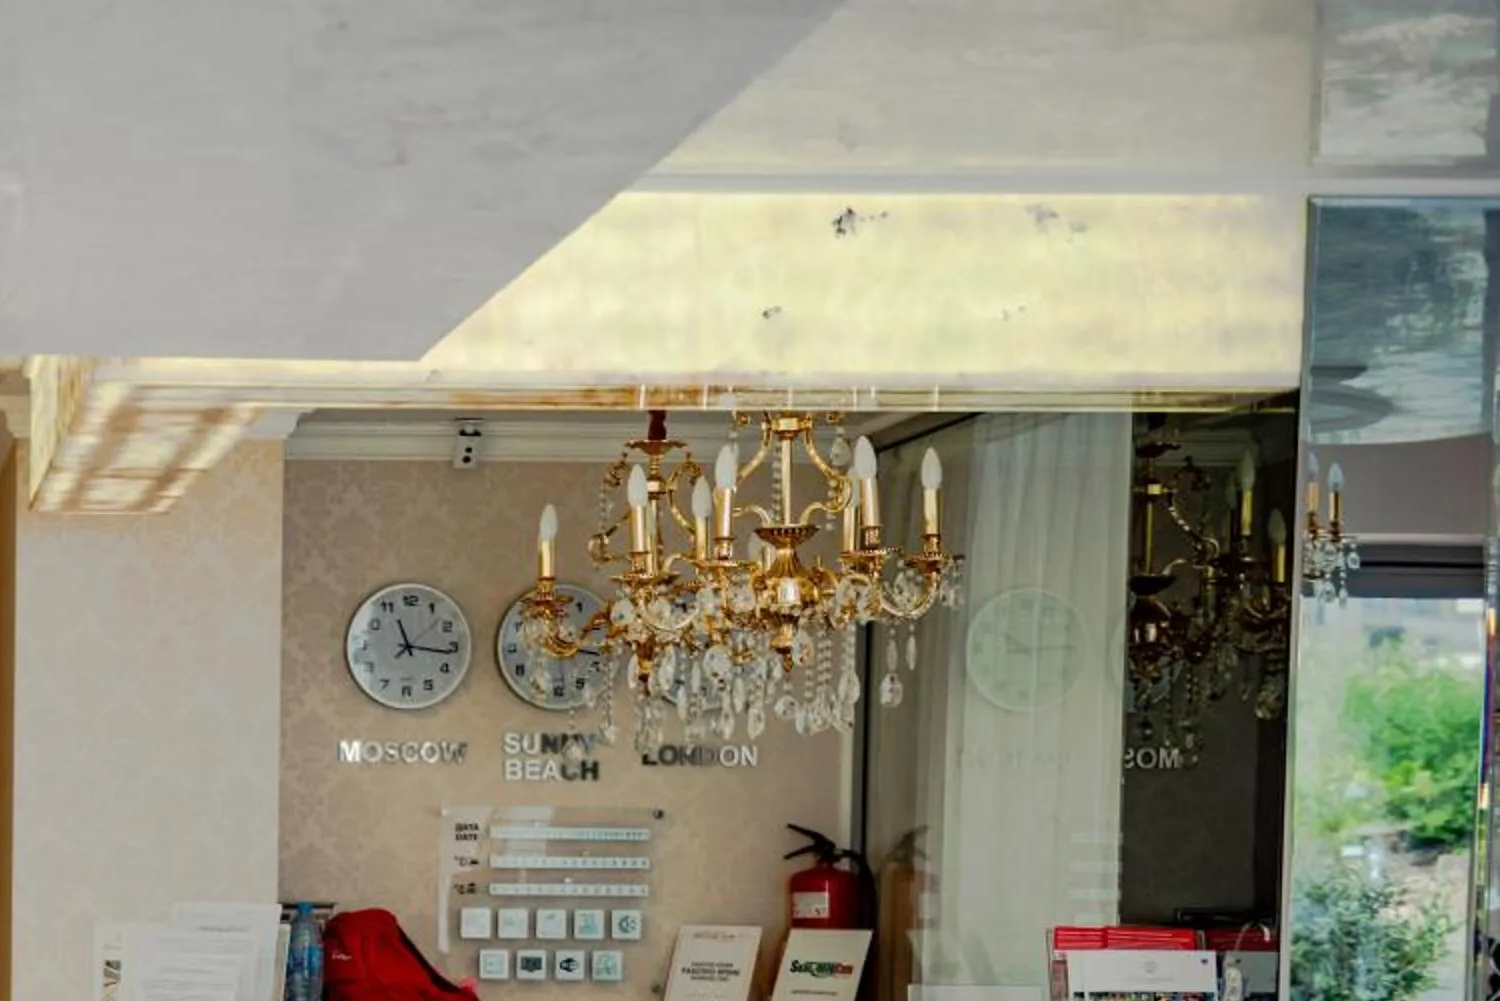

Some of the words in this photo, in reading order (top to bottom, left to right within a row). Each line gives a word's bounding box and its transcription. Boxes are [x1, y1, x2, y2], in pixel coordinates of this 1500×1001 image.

[381, 601, 394, 614] 11
[403, 595, 419, 607] 12
[338, 740, 467, 764] MOSCOW
[641, 745, 758, 767] LONDON
[505, 759, 599, 780] BEACH
